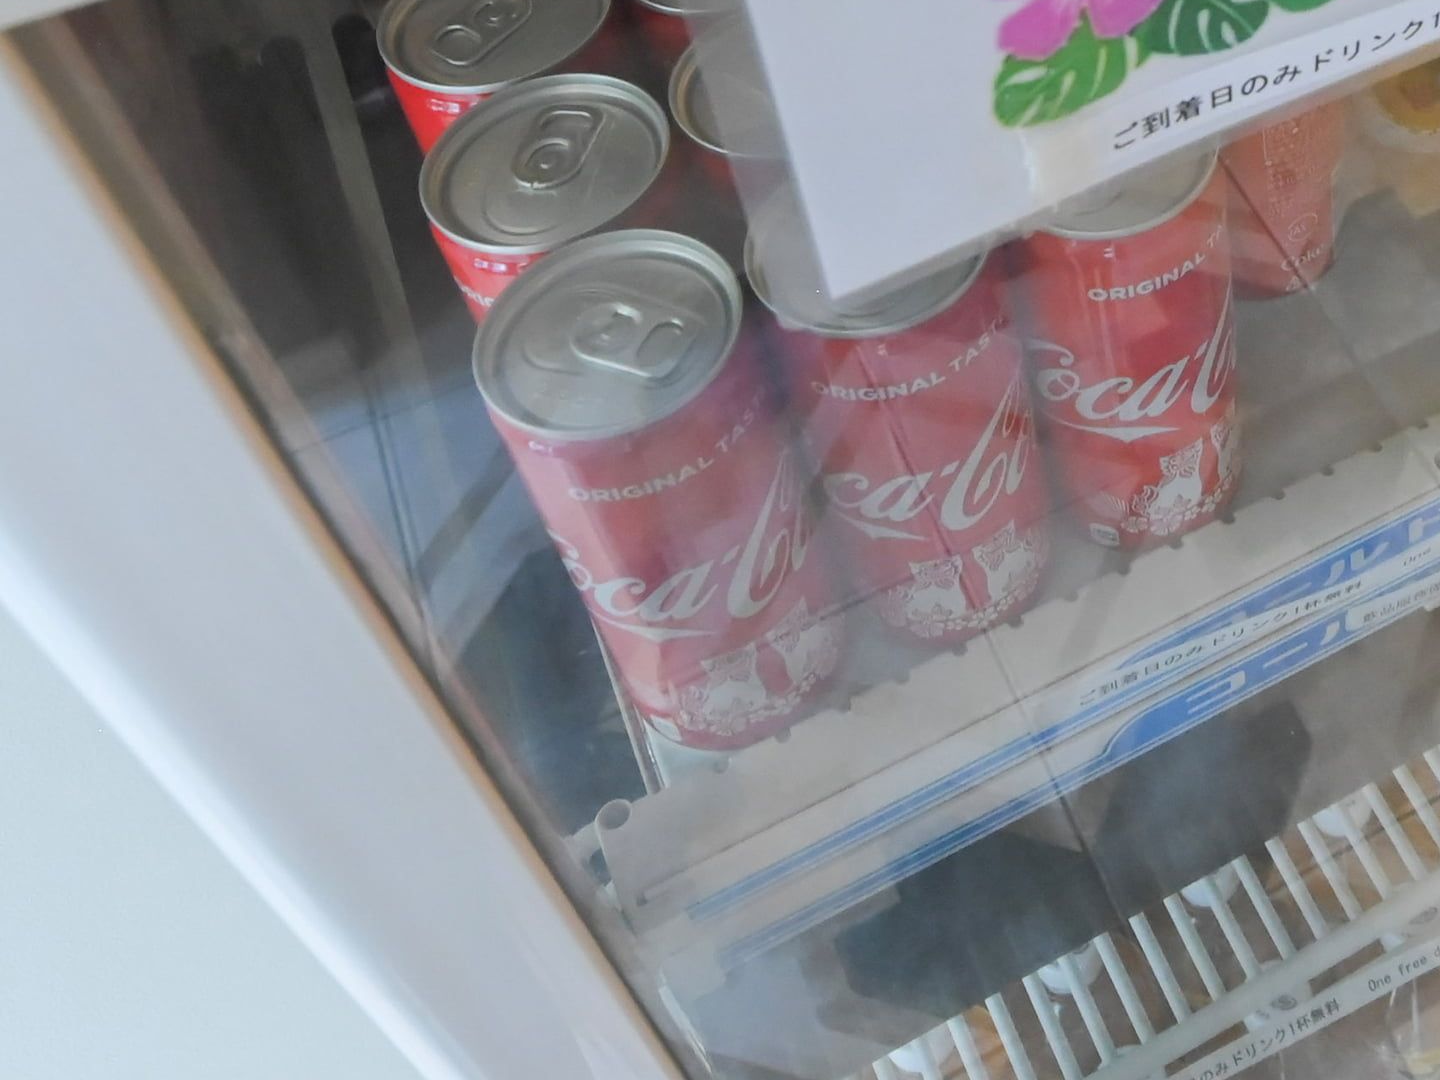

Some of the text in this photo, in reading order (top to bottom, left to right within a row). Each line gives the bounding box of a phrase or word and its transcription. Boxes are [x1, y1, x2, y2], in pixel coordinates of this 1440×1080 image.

[1087, 252, 1206, 302] ORIGINAL
[810, 372, 946, 401] ORIGINAL
[568, 456, 714, 502] ORIGINAL
[1368, 974, 1391, 993] One
[1398, 955, 1428, 977] free
